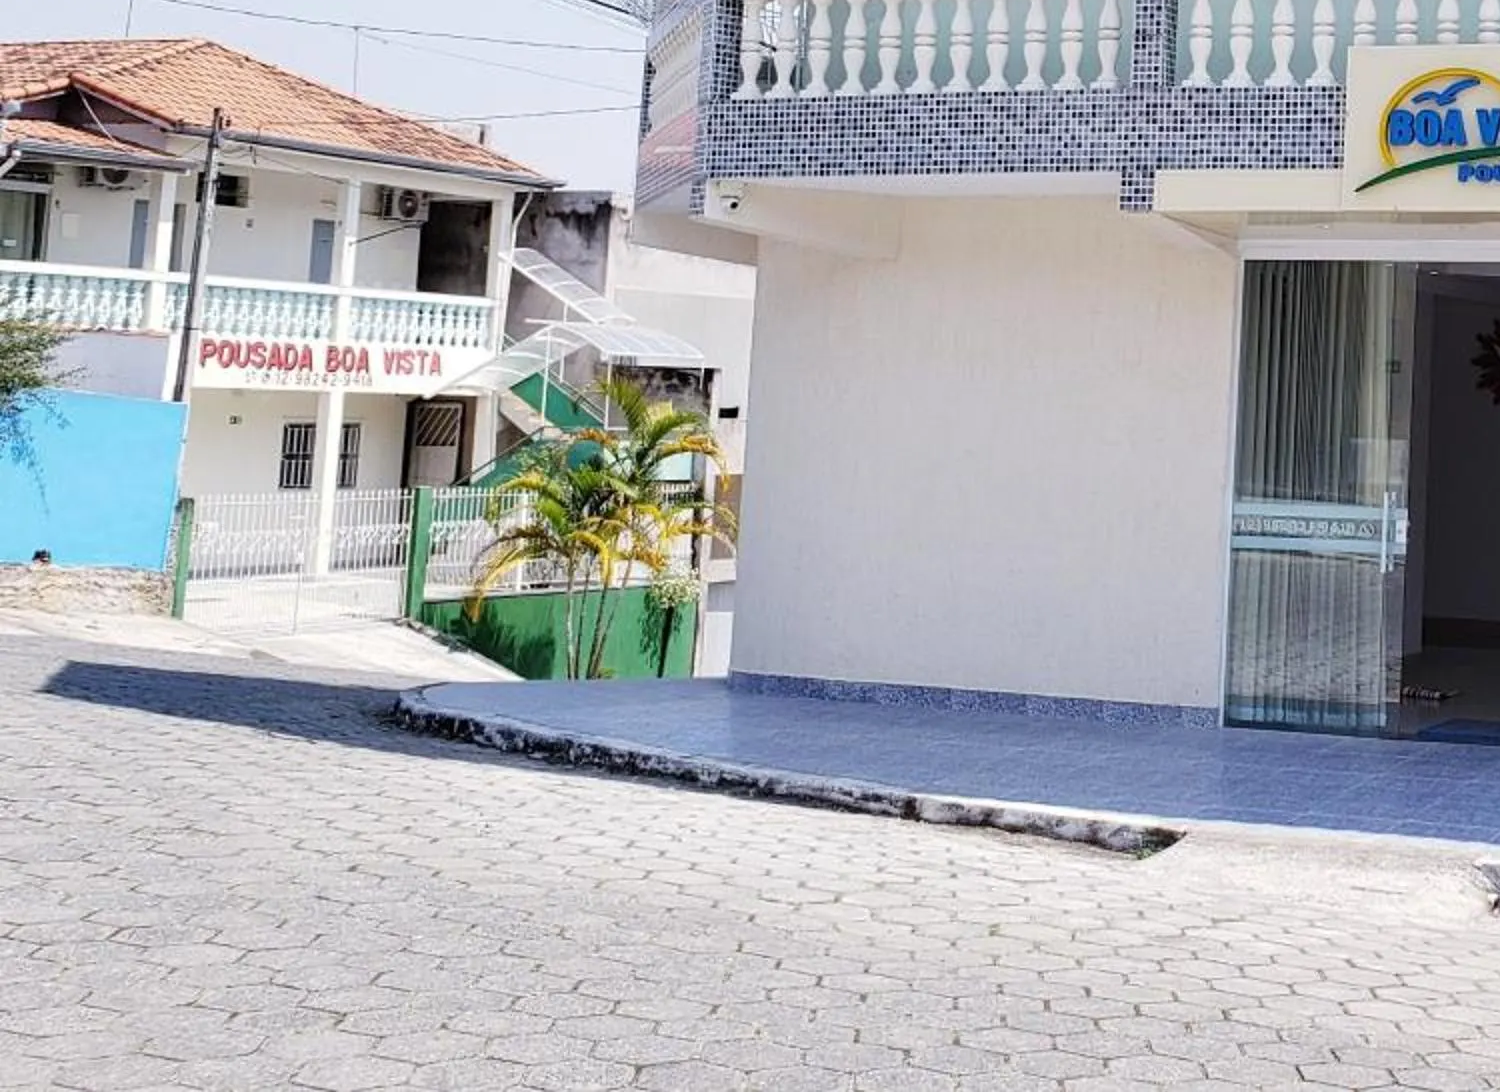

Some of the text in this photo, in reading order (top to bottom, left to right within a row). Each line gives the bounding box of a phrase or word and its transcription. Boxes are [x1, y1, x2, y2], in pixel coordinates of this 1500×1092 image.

[1389, 108, 1467, 146] BOA
[200, 338, 442, 376] POUSADA BOA VISTA
